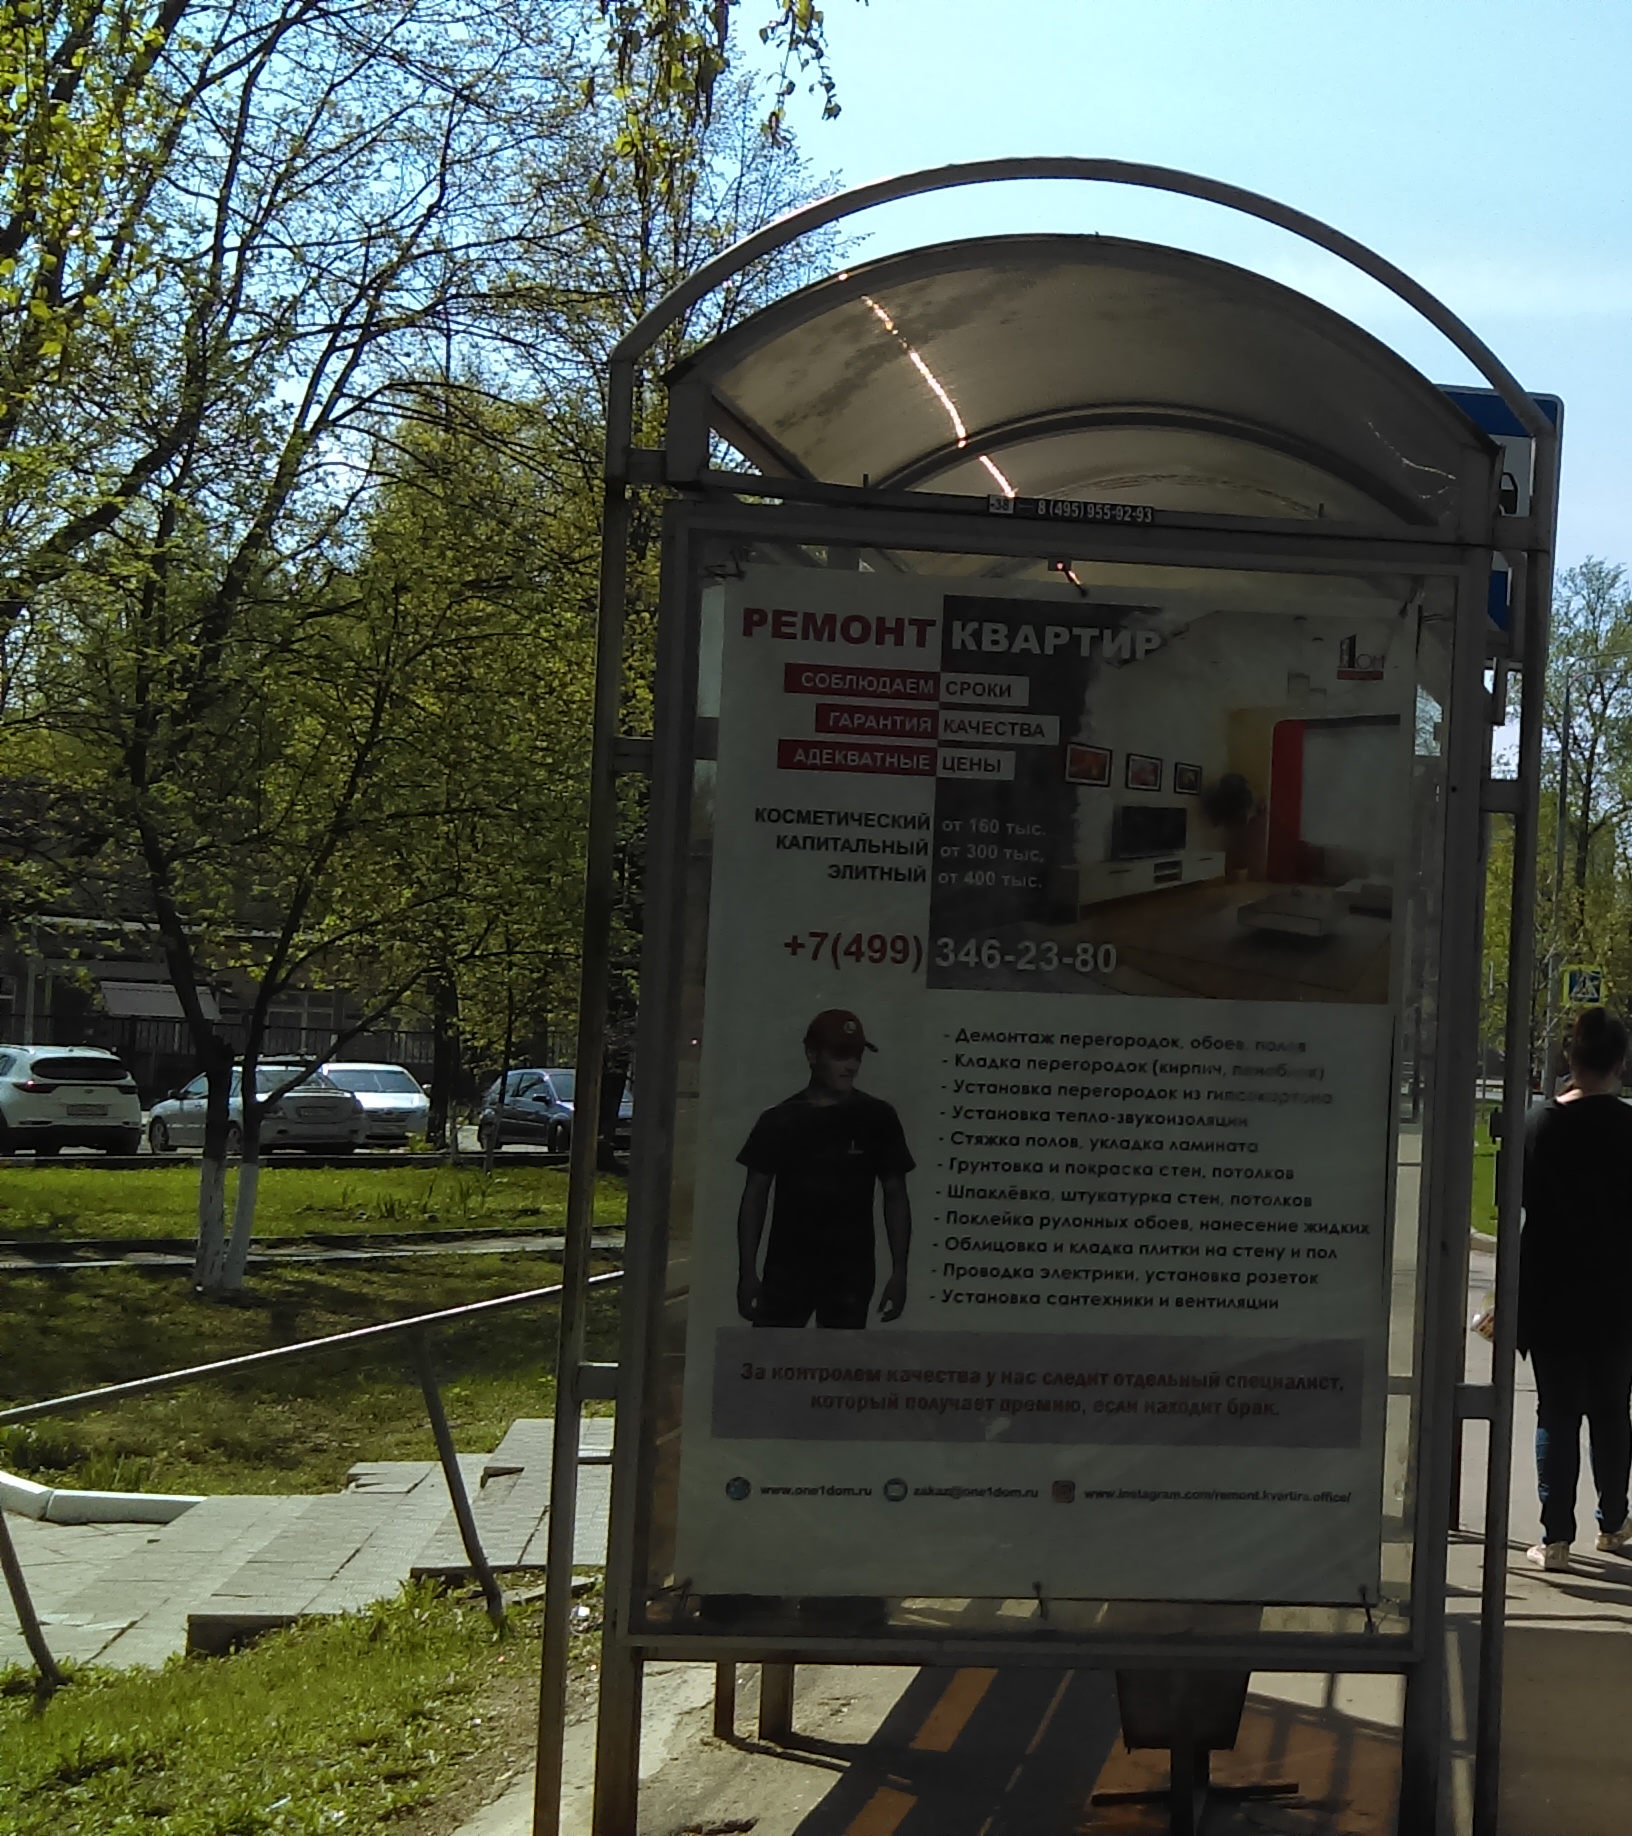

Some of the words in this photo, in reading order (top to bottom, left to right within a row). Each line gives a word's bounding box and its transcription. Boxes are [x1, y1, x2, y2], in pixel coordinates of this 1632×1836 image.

[1050, 500, 1084, 519] (495)
[1087, 504, 1154, 524] 955-92-93
[742, 607, 937, 649] РЕМОНТ
[951, 620, 1164, 661] КВАРТИР
[801, 671, 934, 695] СОБЛЮДАЕМ
[945, 680, 1012, 699] СРОКИ
[829, 711, 932, 734] ГАРАНТИЯ
[943, 717, 1046, 739] КАЧЕСТВА
[794, 746, 931, 771] АДЕКВАТНЫЕ
[942, 756, 1002, 776] ЦЕНЫ
[755, 807, 931, 832] КОСМЕТИЧЕСКИЙ
[942, 819, 963, 832] от
[968, 817, 1000, 835] 160
[1006, 822, 1047, 837] тыс.
[776, 835, 929, 858] КАПИТАЛЬНЫЙ
[940, 845, 961, 859] от
[966, 843, 998, 860] 300
[1003, 848, 1045, 864] тыс.
[828, 862, 927, 884] ЭЛИТНЫЙ
[938, 872, 959, 886] от
[964, 870, 996, 887] 400
[1001, 875, 1043, 890] тыс.
[784, 931, 924, 973] +7(499)
[935, 937, 1118, 974] 346-23-80
[955, 1027, 1055, 1045] Демонтаж
[1060, 1033, 1184, 1051] перегородок,
[1255, 1041, 1307, 1053] полв
[955, 1054, 1021, 1070] Кладка
[1027, 1058, 1147, 1075] перегородок
[1152, 1060, 1227, 1079] (кирпич,
[953, 1079, 1052, 1096] Установка
[1057, 1084, 1178, 1101] перегородок
[1183, 1090, 1202, 1101] из
[951, 1105, 1051, 1122] Установка
[1056, 1111, 1249, 1129] тепло-звукоизоляции
[951, 1131, 1021, 1148] Стяжка
[1025, 1137, 1084, 1151] полов,
[1090, 1138, 1164, 1153] укладка
[1168, 1141, 1259, 1153] ламината
[949, 1157, 1043, 1174] Грунтовка
[1049, 1163, 1060, 1174] и
[1065, 1163, 1154, 1178] покраска
[1159, 1166, 1206, 1179] стен,
[1212, 1168, 1295, 1180] потолков
[948, 1184, 1055, 1203] Шпаклёвка,
[1061, 1190, 1172, 1206] штукатурка
[1177, 1192, 1225, 1206] стен,
[1230, 1194, 1313, 1207] потолков
[946, 1210, 1035, 1227] Поклейка
[1040, 1215, 1129, 1230] рулонных
[1134, 1216, 1194, 1232] обоев,
[1199, 1220, 1299, 1233] нанесение
[1304, 1222, 1370, 1235] жидких
[945, 1237, 1048, 1254] Облицовка
[1053, 1242, 1064, 1253] и
[1070, 1242, 1134, 1256] кладка
[1139, 1244, 1200, 1257] плитки
[1205, 1246, 1227, 1258] на
[1233, 1246, 1285, 1261] стену
[1291, 1247, 1301, 1258] и
[1306, 1248, 1337, 1260] пол
[943, 1263, 1034, 1280] Проводка
[1040, 1267, 1139, 1282] электрики,
[1145, 1269, 1241, 1285] установка
[1246, 1272, 1319, 1287] розеток
[942, 1289, 1041, 1306] Установка
[1047, 1293, 1154, 1308] сантехники
[1159, 1296, 1169, 1308] и
[1175, 1297, 1279, 1311] вентиляции
[741, 1362, 765, 1380] За
[772, 1365, 881, 1383] контролем
[887, 1367, 980, 1384] качества
[986, 1369, 995, 1387] у
[1001, 1369, 1036, 1385] нас
[1042, 1371, 1109, 1389] следит
[1113, 1371, 1220, 1390] отдельный
[1225, 1374, 1344, 1392] специалист,
[811, 1393, 899, 1412] который
[905, 1396, 995, 1415] получает
[1000, 1397, 1087, 1416] премию,
[1093, 1400, 1139, 1415] если
[1144, 1400, 1223, 1418] находит
[1227, 1397, 1280, 1419] брак.
[760, 1484, 873, 1498] www.one1dom.ru
